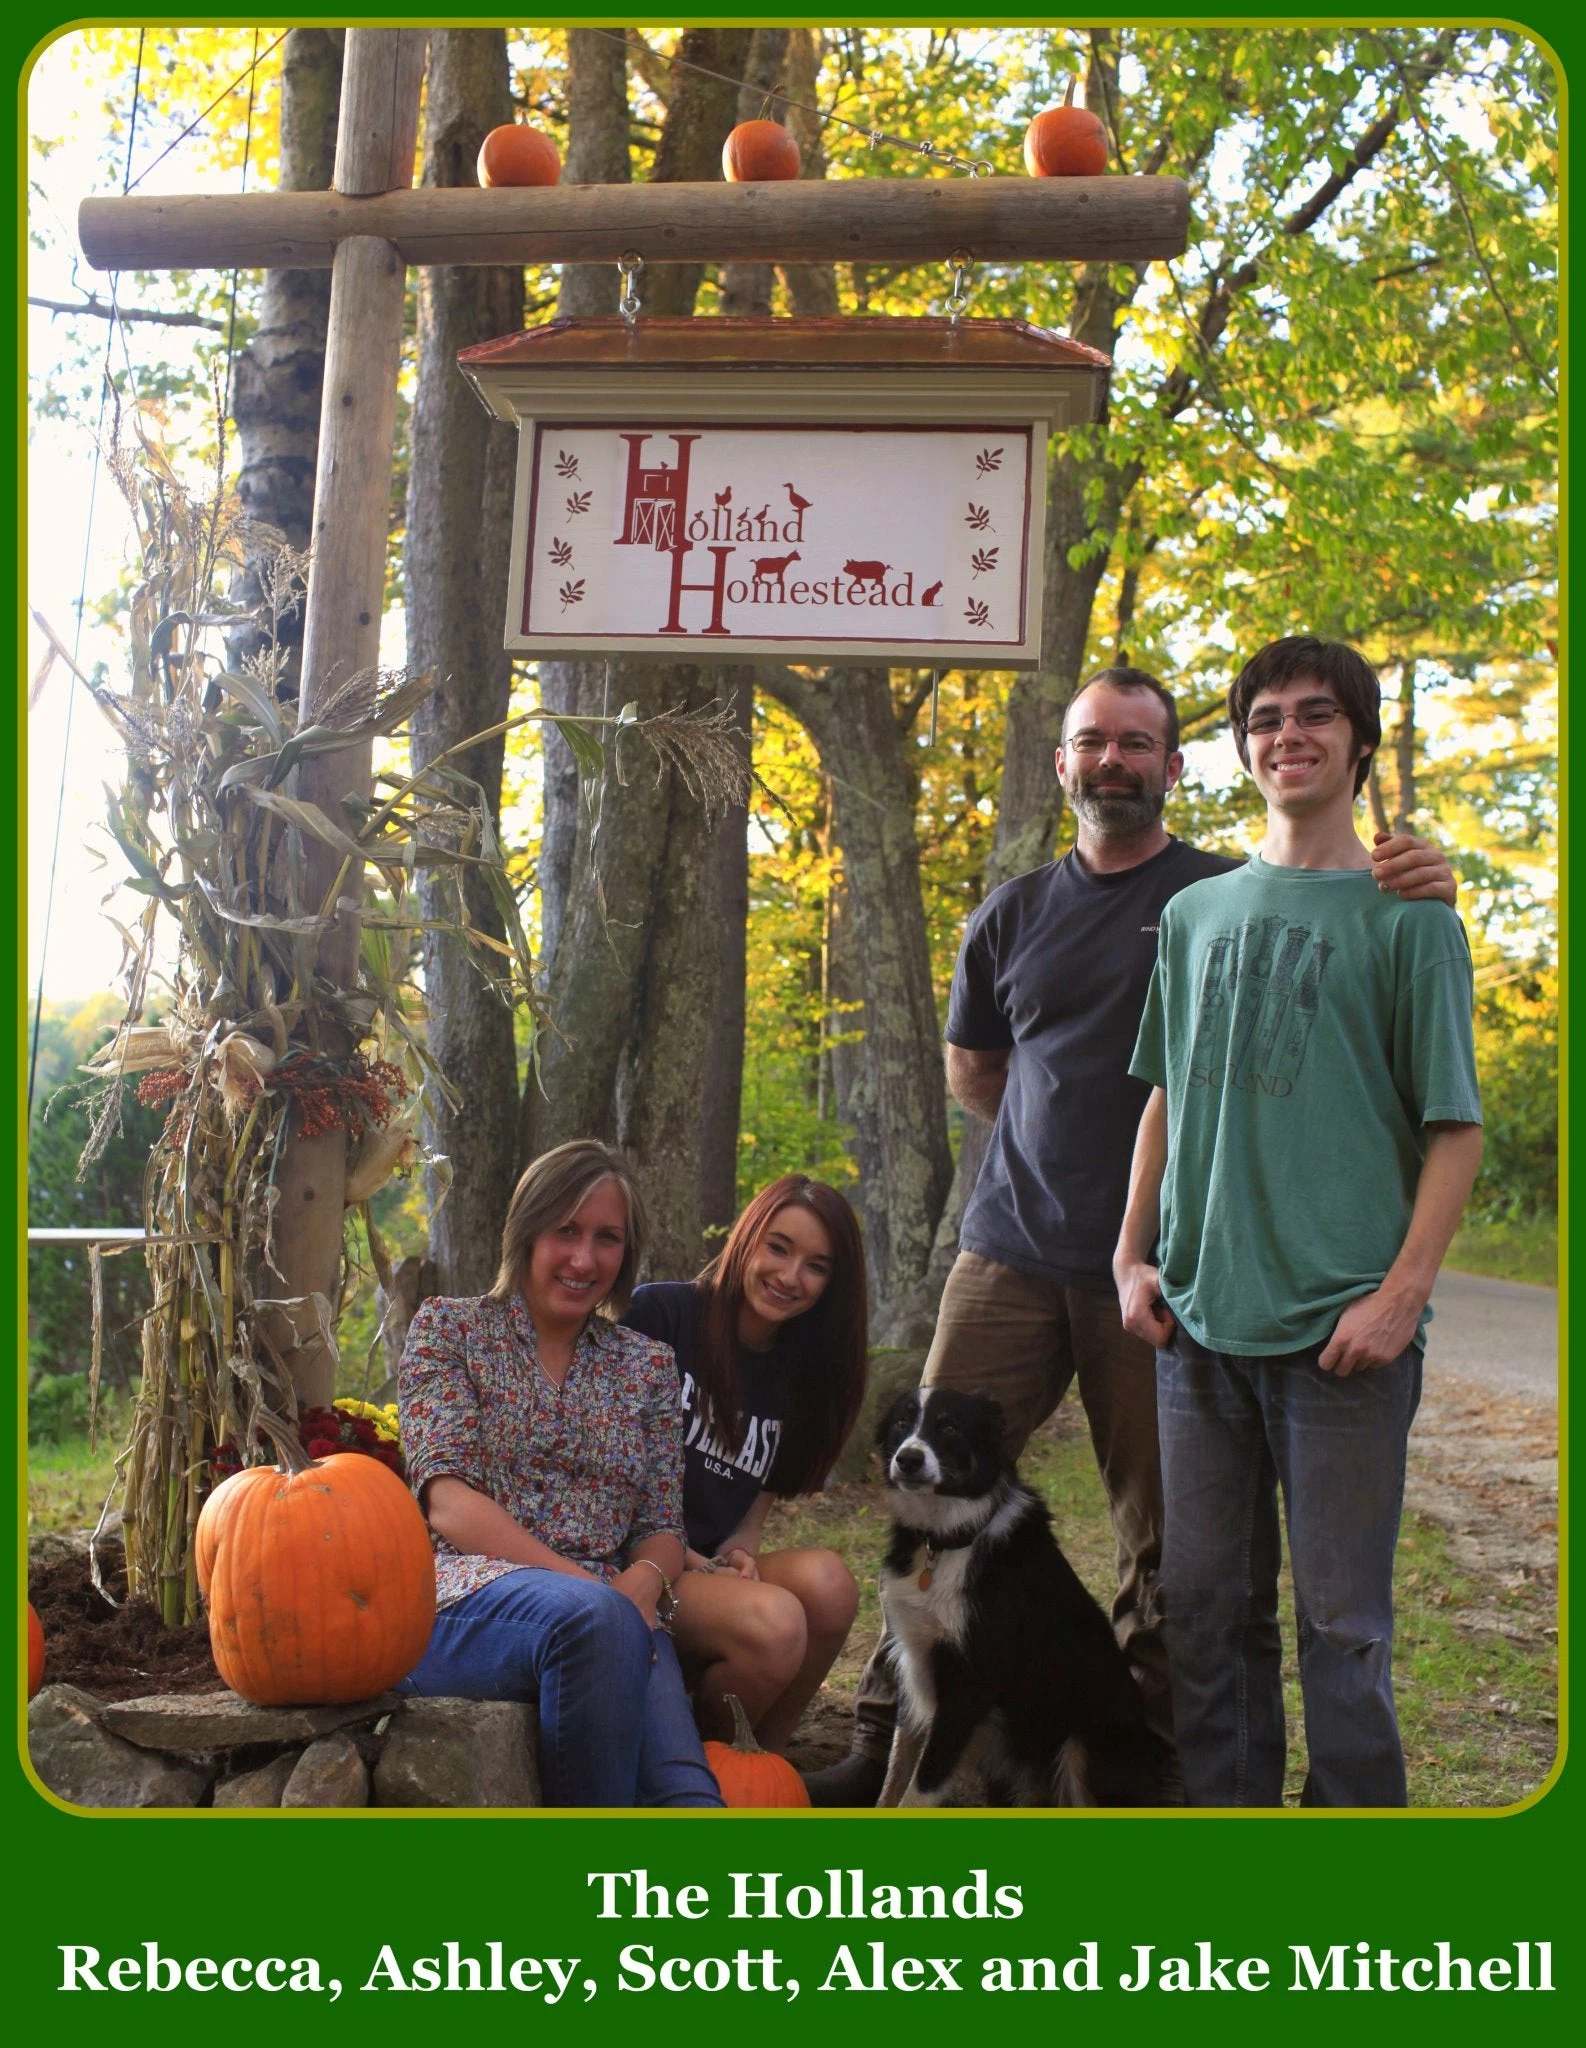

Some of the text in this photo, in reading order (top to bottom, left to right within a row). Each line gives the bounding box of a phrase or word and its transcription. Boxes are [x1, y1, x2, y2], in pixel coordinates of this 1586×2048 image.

[613, 433, 805, 551] Holland
[658, 546, 915, 634] Homestead
[704, 1457, 734, 1480] U.S.A.
